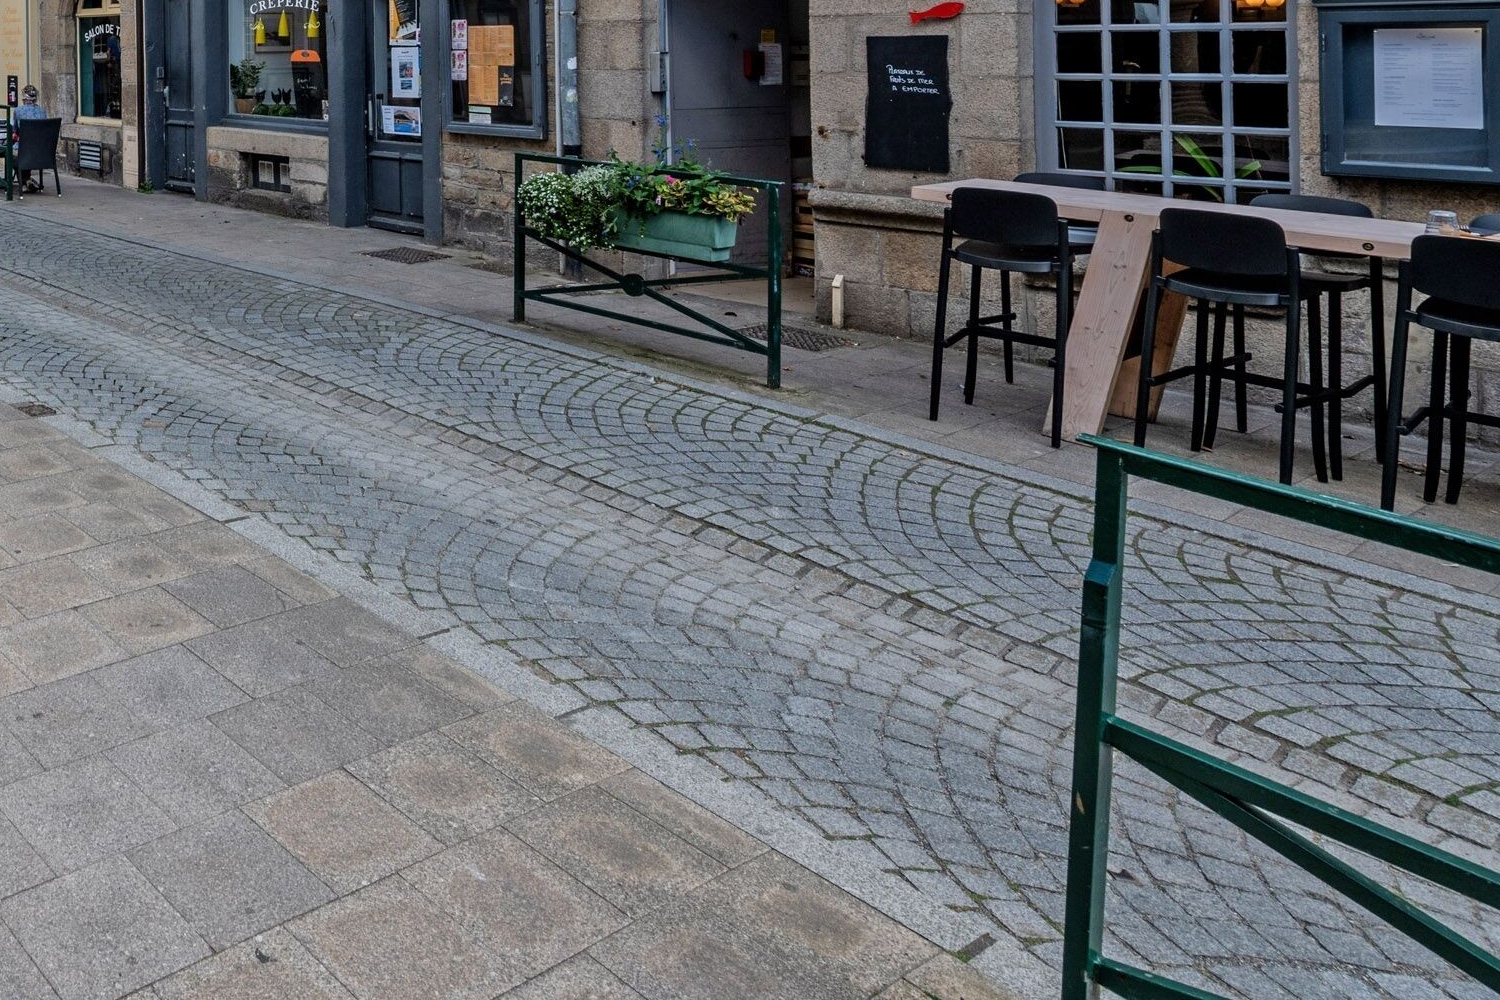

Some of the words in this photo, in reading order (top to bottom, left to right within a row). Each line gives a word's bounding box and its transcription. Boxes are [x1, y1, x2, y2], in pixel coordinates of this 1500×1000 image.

[84, 23, 104, 42] SALON
[105, 23, 114, 35] DE
[901, 85, 940, 95] EMPORTER
